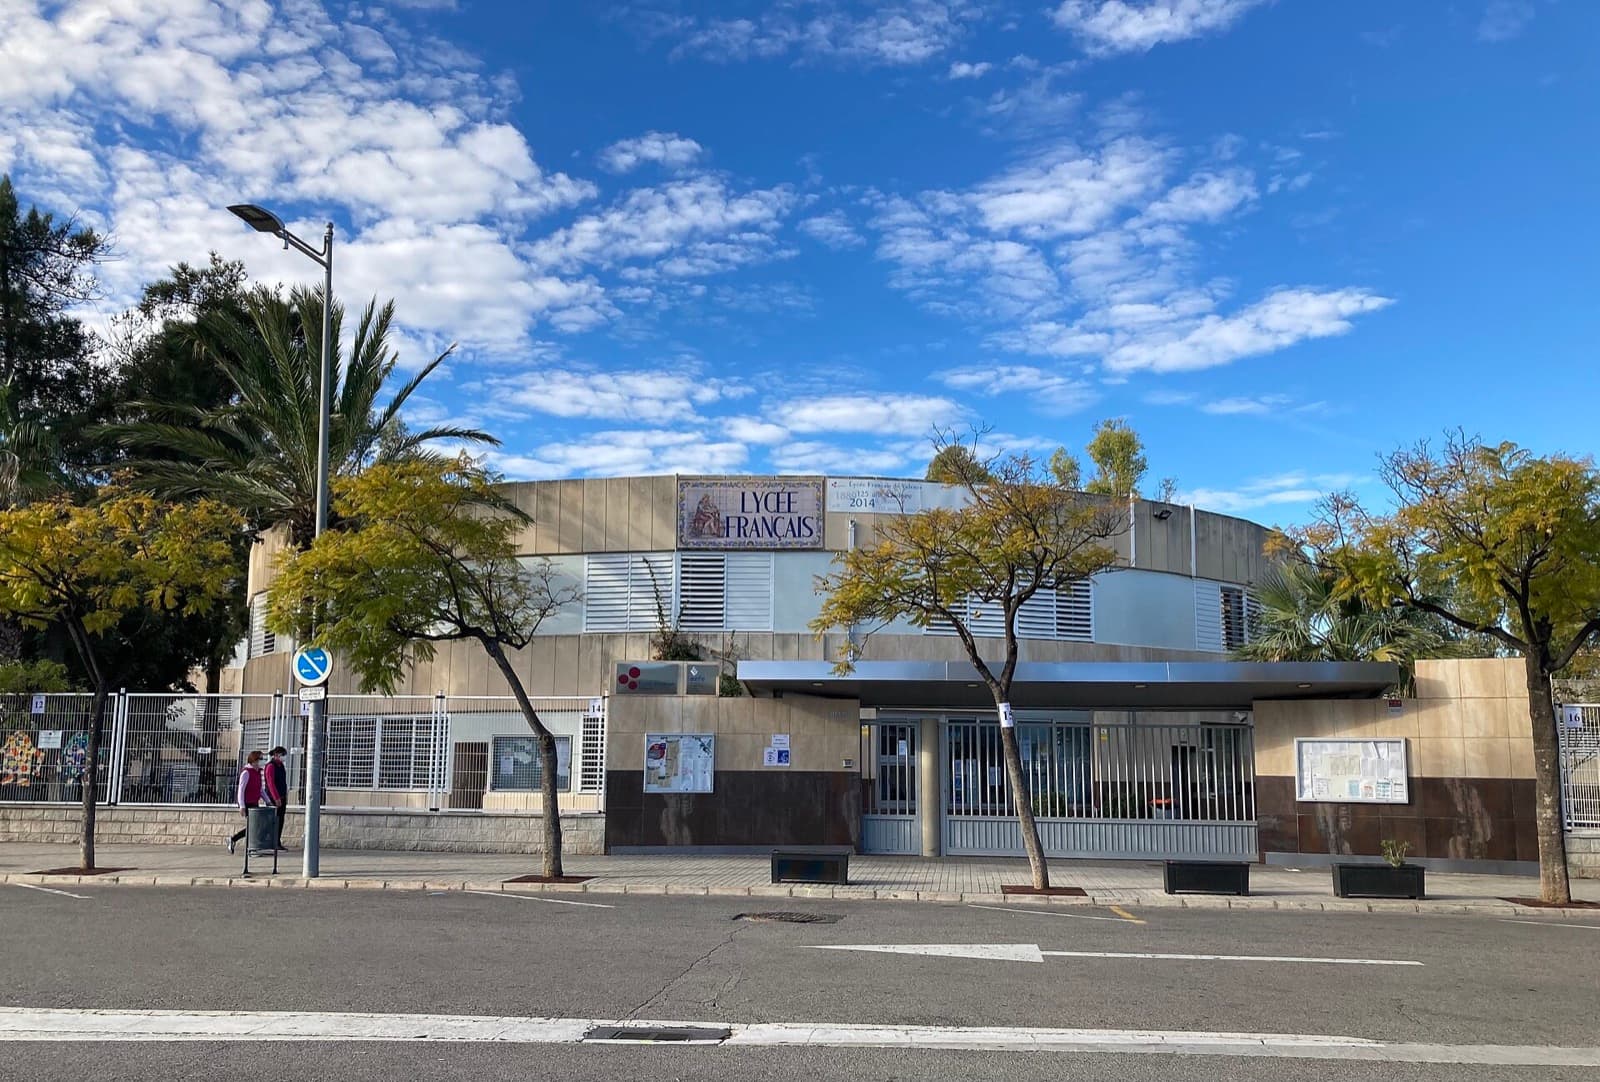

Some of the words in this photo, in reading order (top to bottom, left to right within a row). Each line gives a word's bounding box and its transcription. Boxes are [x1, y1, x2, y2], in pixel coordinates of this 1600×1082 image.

[741, 487, 799, 514] LYCÉE
[850, 498, 875, 508] 2014
[725, 516, 814, 541] FRANÇAIS
[35, 701, 43, 709] 12
[592, 705, 601, 713] 14
[1569, 713, 1580, 722] 16
